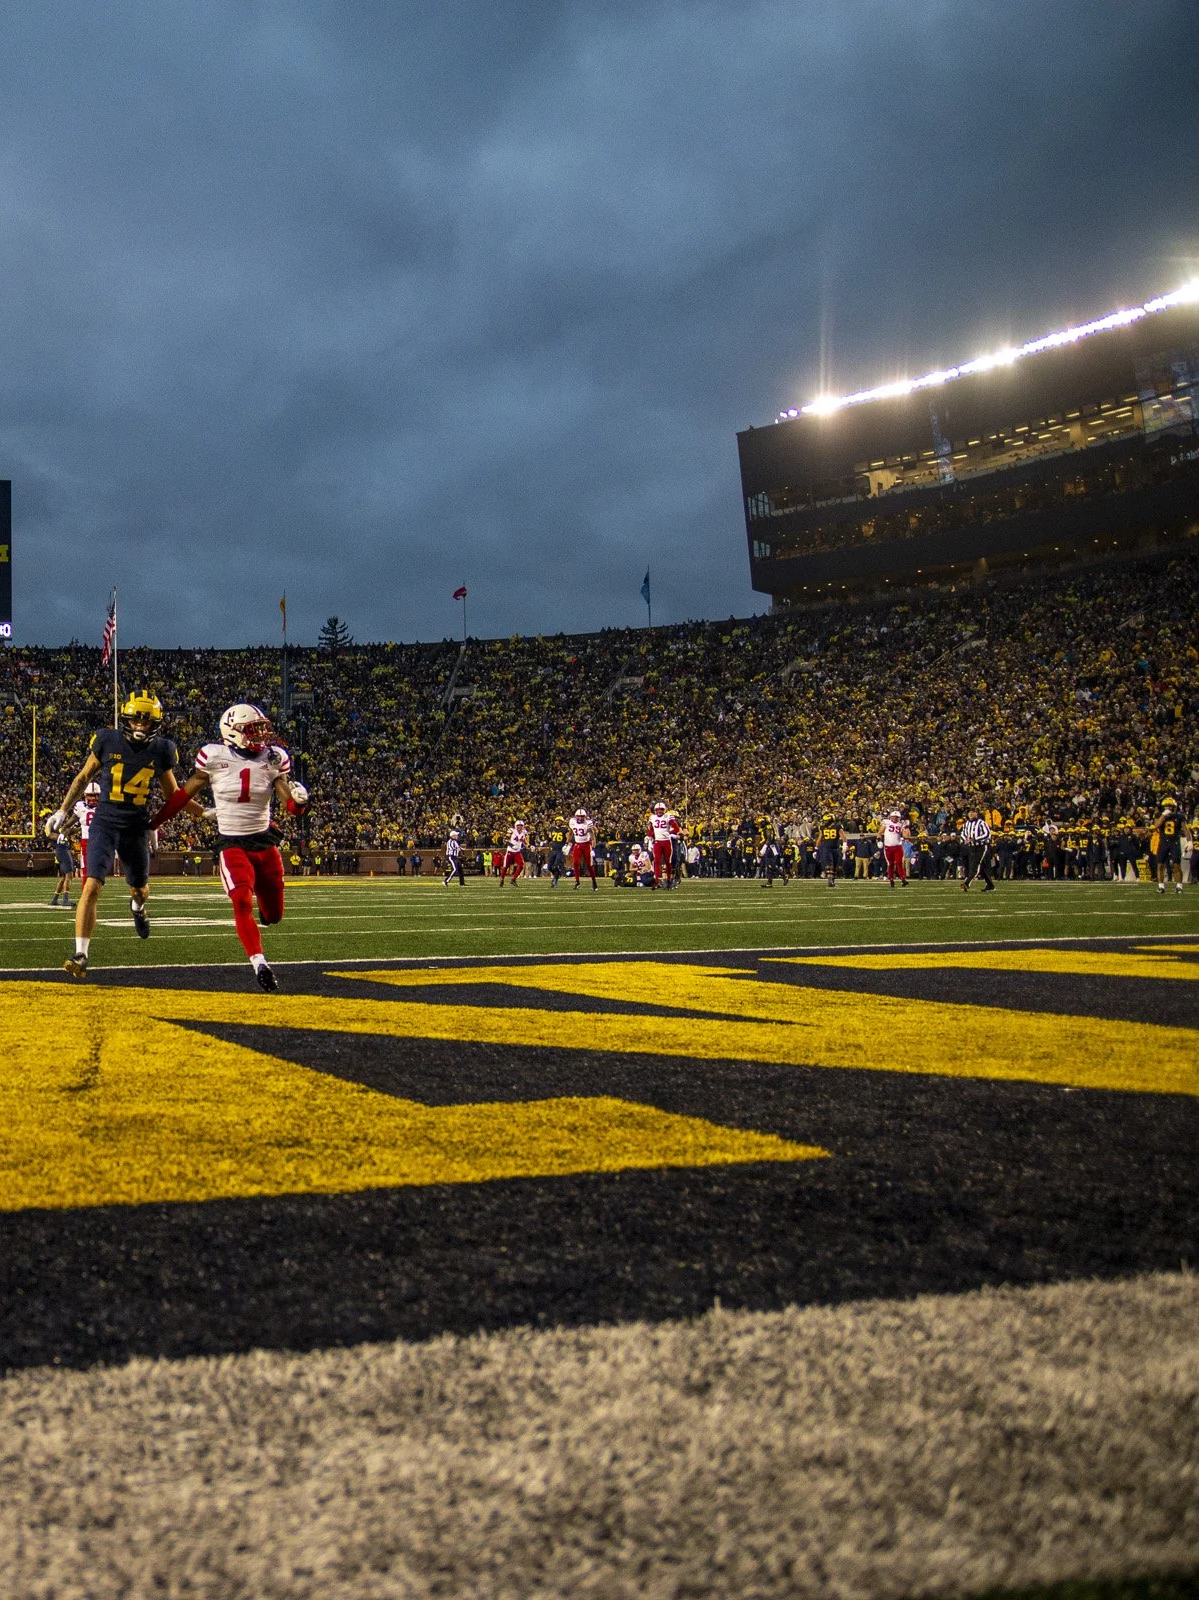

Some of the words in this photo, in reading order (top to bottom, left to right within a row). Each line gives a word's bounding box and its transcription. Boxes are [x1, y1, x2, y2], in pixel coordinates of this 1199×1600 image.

[109, 763, 154, 805] 14
[237, 768, 252, 803] 1
[654, 820, 667, 829] 32
[1164, 821, 1175, 835] 8
[551, 832, 563, 842] 76
[573, 828, 586, 837] 33
[823, 829, 837, 840] 58
[920, 843, 929, 851] 13
